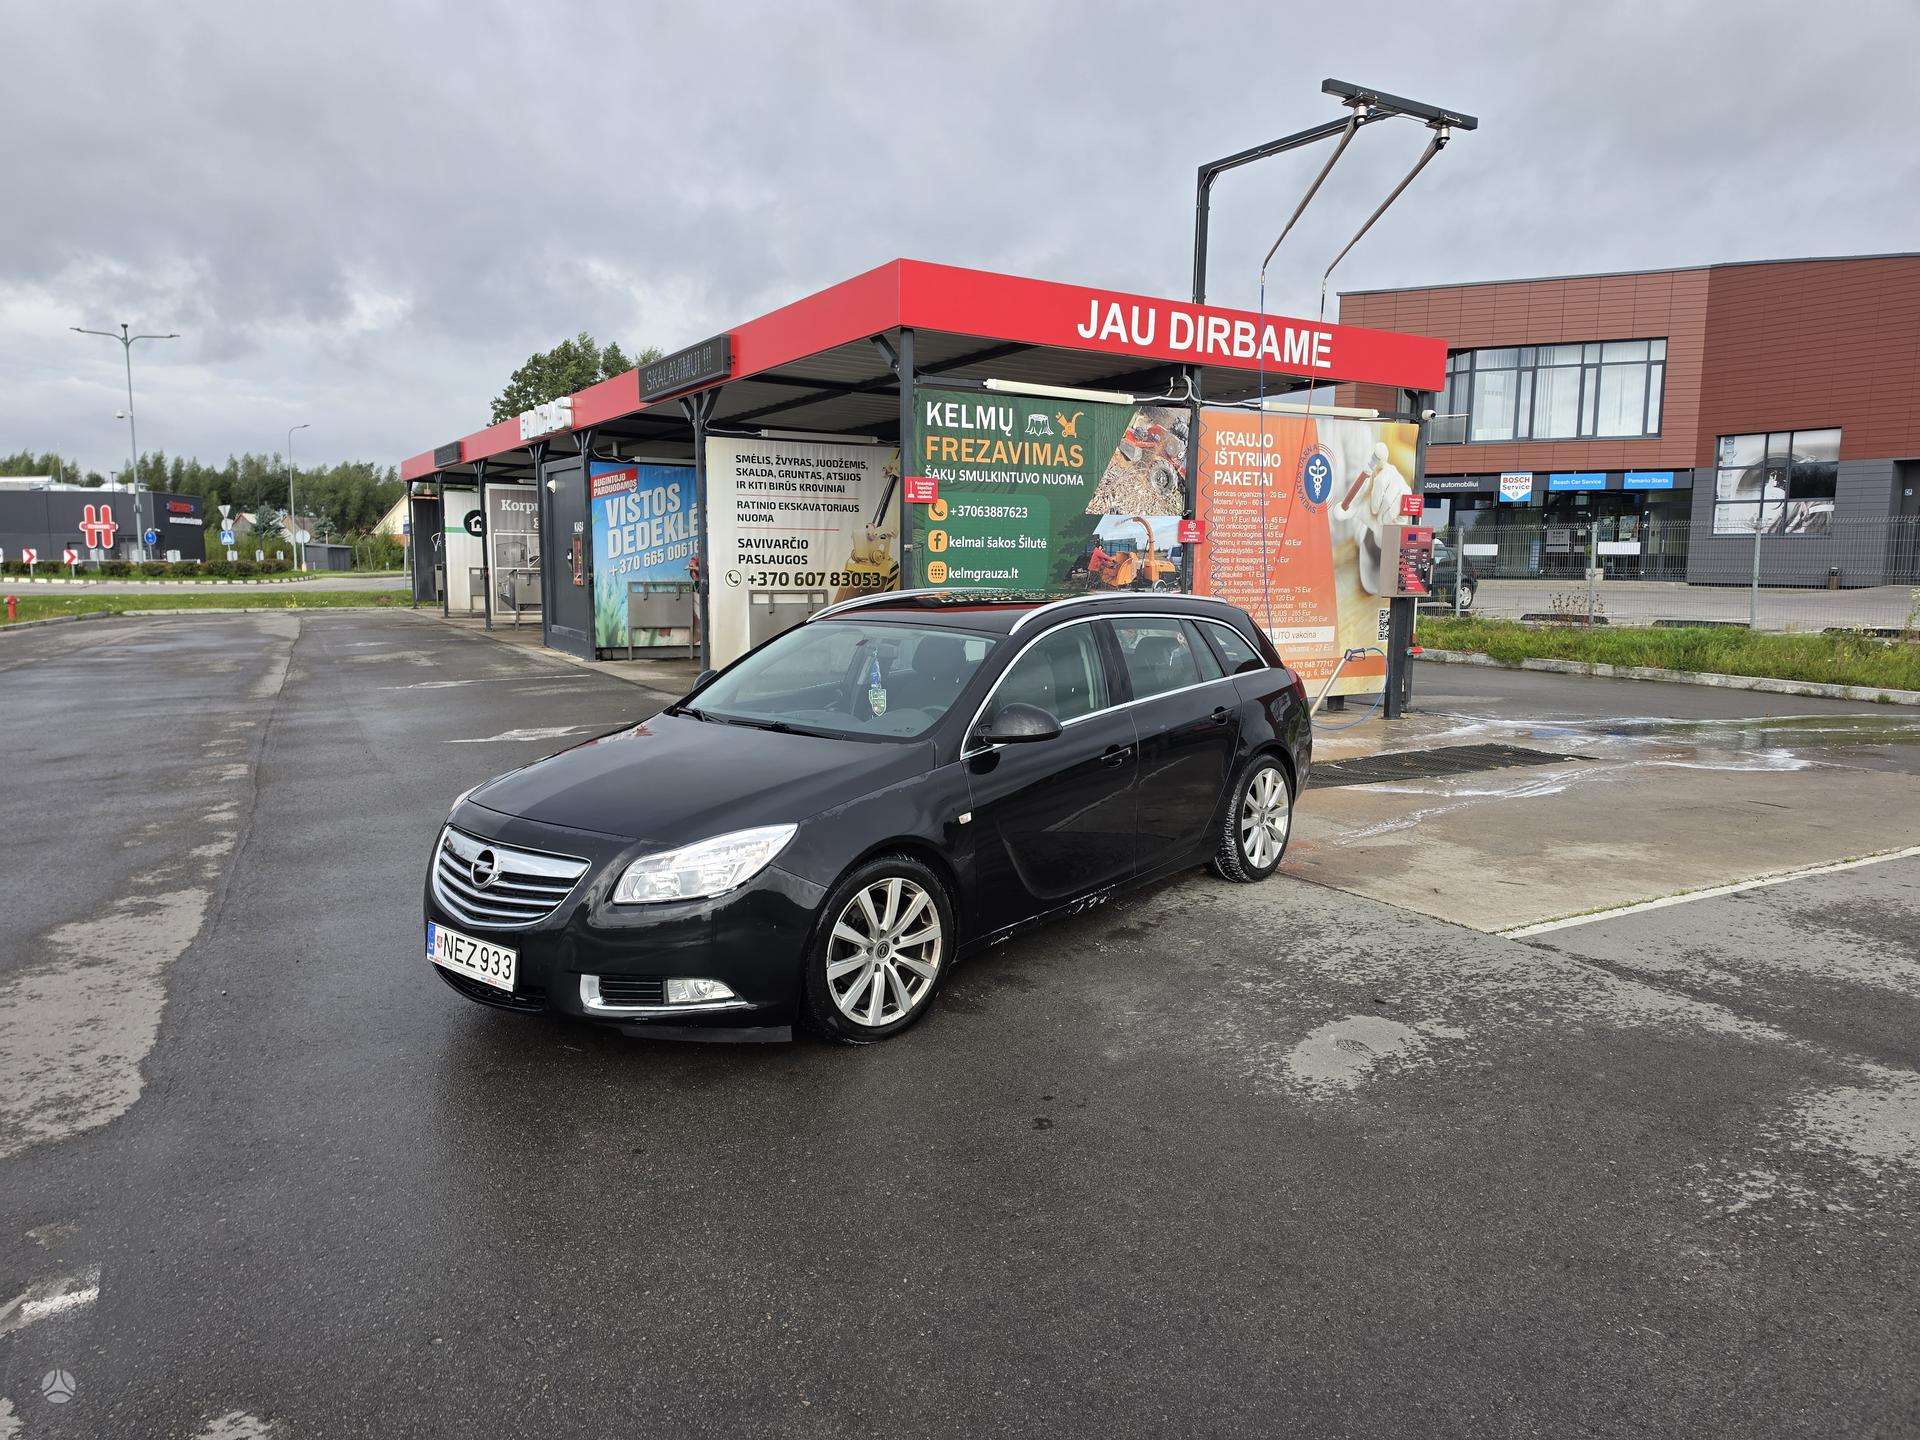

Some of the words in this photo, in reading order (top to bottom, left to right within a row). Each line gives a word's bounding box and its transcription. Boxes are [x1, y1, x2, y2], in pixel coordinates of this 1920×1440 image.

[1077, 299, 1156, 346] JAU
[1168, 311, 1333, 369] DIRBAME
[926, 401, 1014, 437] KELMŲ
[1215, 430, 1274, 448] KRAUJO
[926, 435, 1085, 468] FREZAVIMAS
[1214, 446, 1282, 468] IŠTYRIMO
[735, 452, 774, 466] SMĖLIS,
[775, 454, 814, 468] ŽVYRAS,
[815, 457, 869, 471] JUODŽEMIS,
[593, 472, 626, 488] AUGINTOJO
[735, 467, 777, 479] SKALDA,
[778, 469, 825, 482] GRUNTAS,
[826, 471, 862, 482] ATSIJOS
[925, 464, 956, 482] ŠAKŲ
[958, 468, 1041, 486] SMULKINTUVO
[1042, 472, 1085, 487] NUOMA
[1213, 470, 1273, 487] PAKETAI
[1502, 476, 1531, 485] BOSCH
[736, 480, 747, 490] IR
[748, 481, 768, 491] KITI
[769, 480, 797, 492] BIRŪS
[798, 483, 846, 494] KROVINIAI
[1502, 483, 1531, 491] Service
[604, 483, 681, 528] VIŠTOS
[736, 500, 777, 511] RATINIO
[778, 502, 860, 514] EKSKAVATORIAUS
[950, 505, 1029, 519] +37063887623
[737, 513, 775, 524] NUOMA
[737, 536, 809, 550] SAVIVARČIO
[948, 535, 985, 549] kelmai
[986, 535, 1016, 550] šakos
[1018, 533, 1048, 550] Šilutė
[608, 554, 641, 576] +370
[643, 548, 666, 568] 665
[738, 554, 809, 565] PASLAUGOS
[747, 571, 790, 587] +370
[794, 572, 826, 587] 607
[829, 572, 882, 588] 83053
[948, 566, 1020, 585] kelmgrauza.lt
[443, 932, 512, 980] NEZ933
